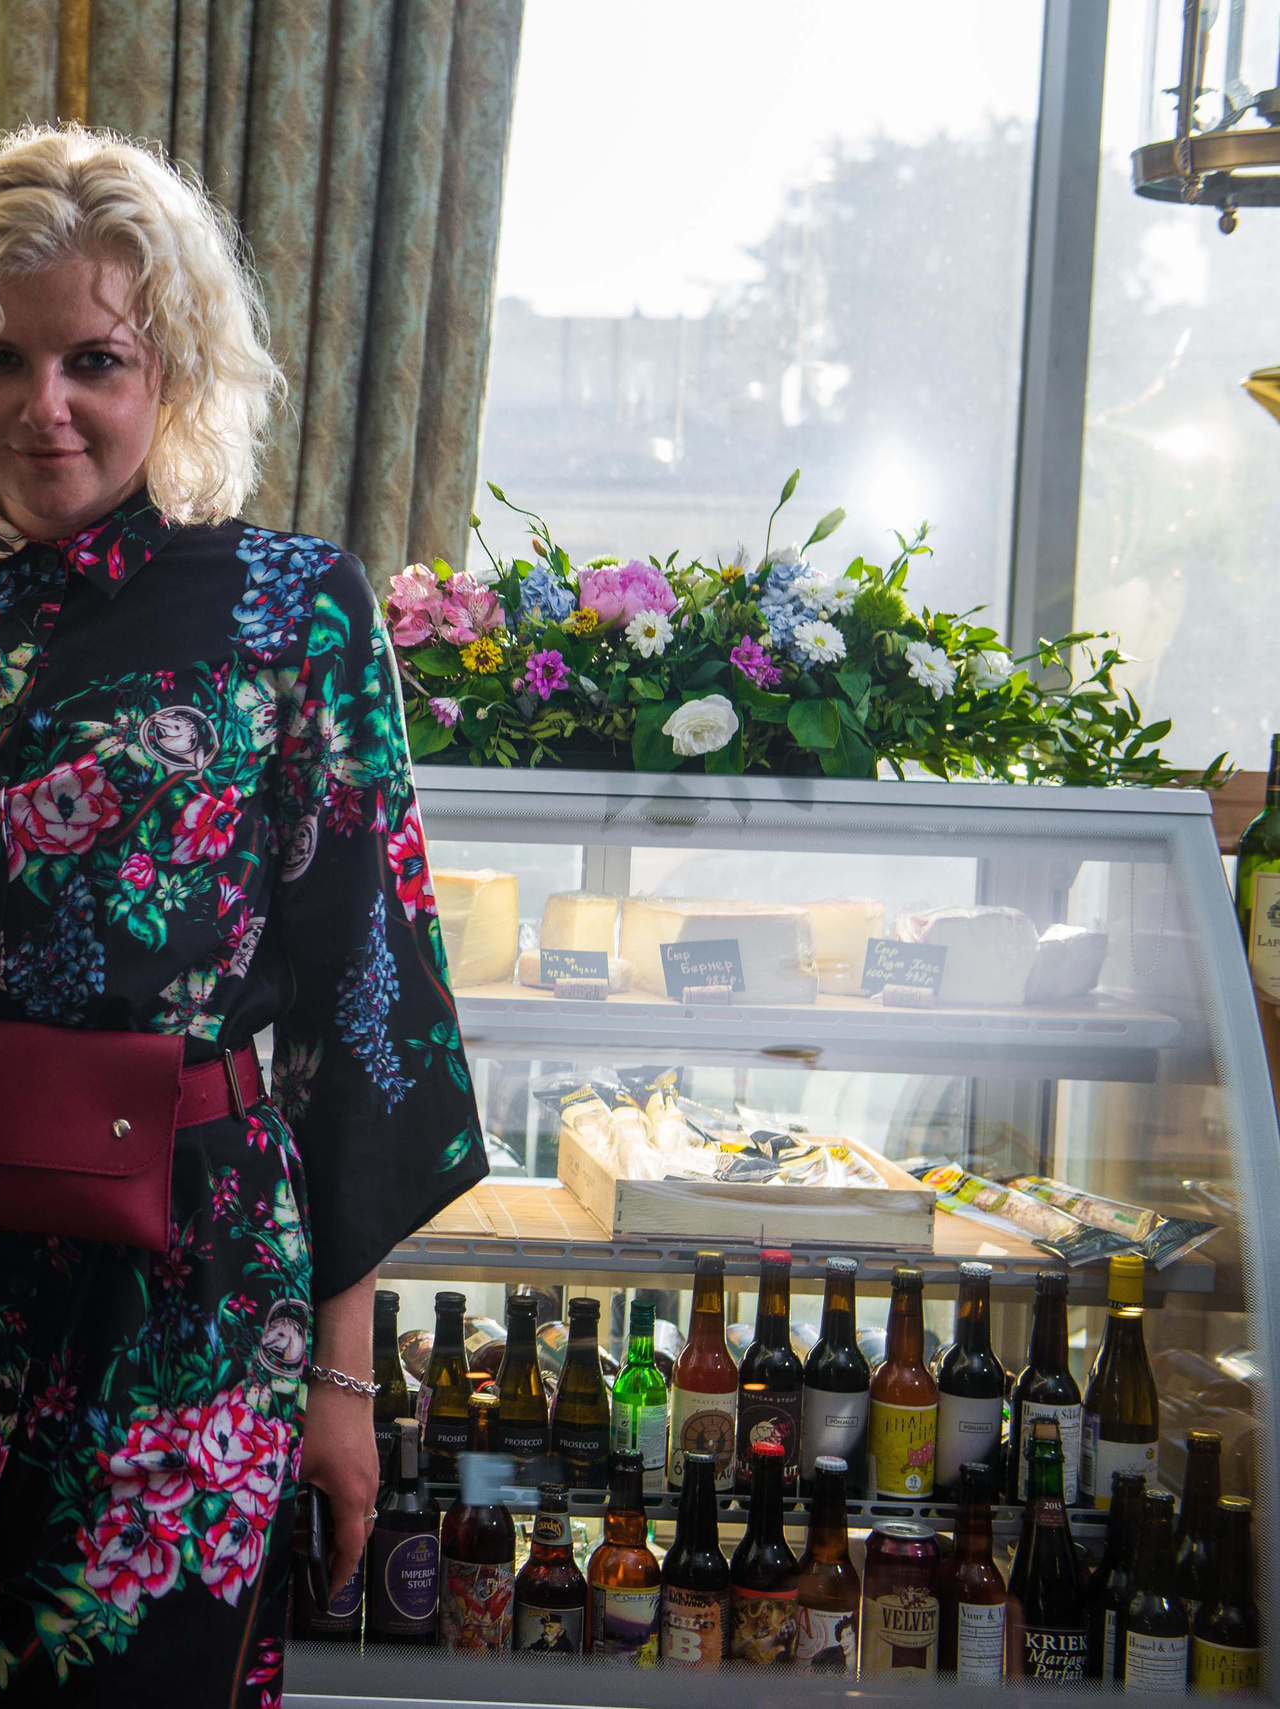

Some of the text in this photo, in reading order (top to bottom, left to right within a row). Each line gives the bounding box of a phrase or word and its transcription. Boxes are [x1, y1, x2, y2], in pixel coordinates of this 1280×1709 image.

[1257, 935, 1280, 947] LAF
[667, 946, 691, 962] Сыр
[680, 961, 733, 974] Бернер
[503, 1437, 543, 1448] PROSECCO
[559, 1438, 600, 1450] PROSECCO
[400, 1567, 437, 1579] IMPERIAL
[407, 1578, 434, 1589] STOUT
[882, 1607, 936, 1631] VELVET
[961, 1606, 983, 1620] Vuur
[667, 1627, 702, 1661] B
[1025, 1632, 1088, 1651] KRIEK
[1128, 1635, 1156, 1651] Hemel
[1027, 1648, 1087, 1670] Mariage
